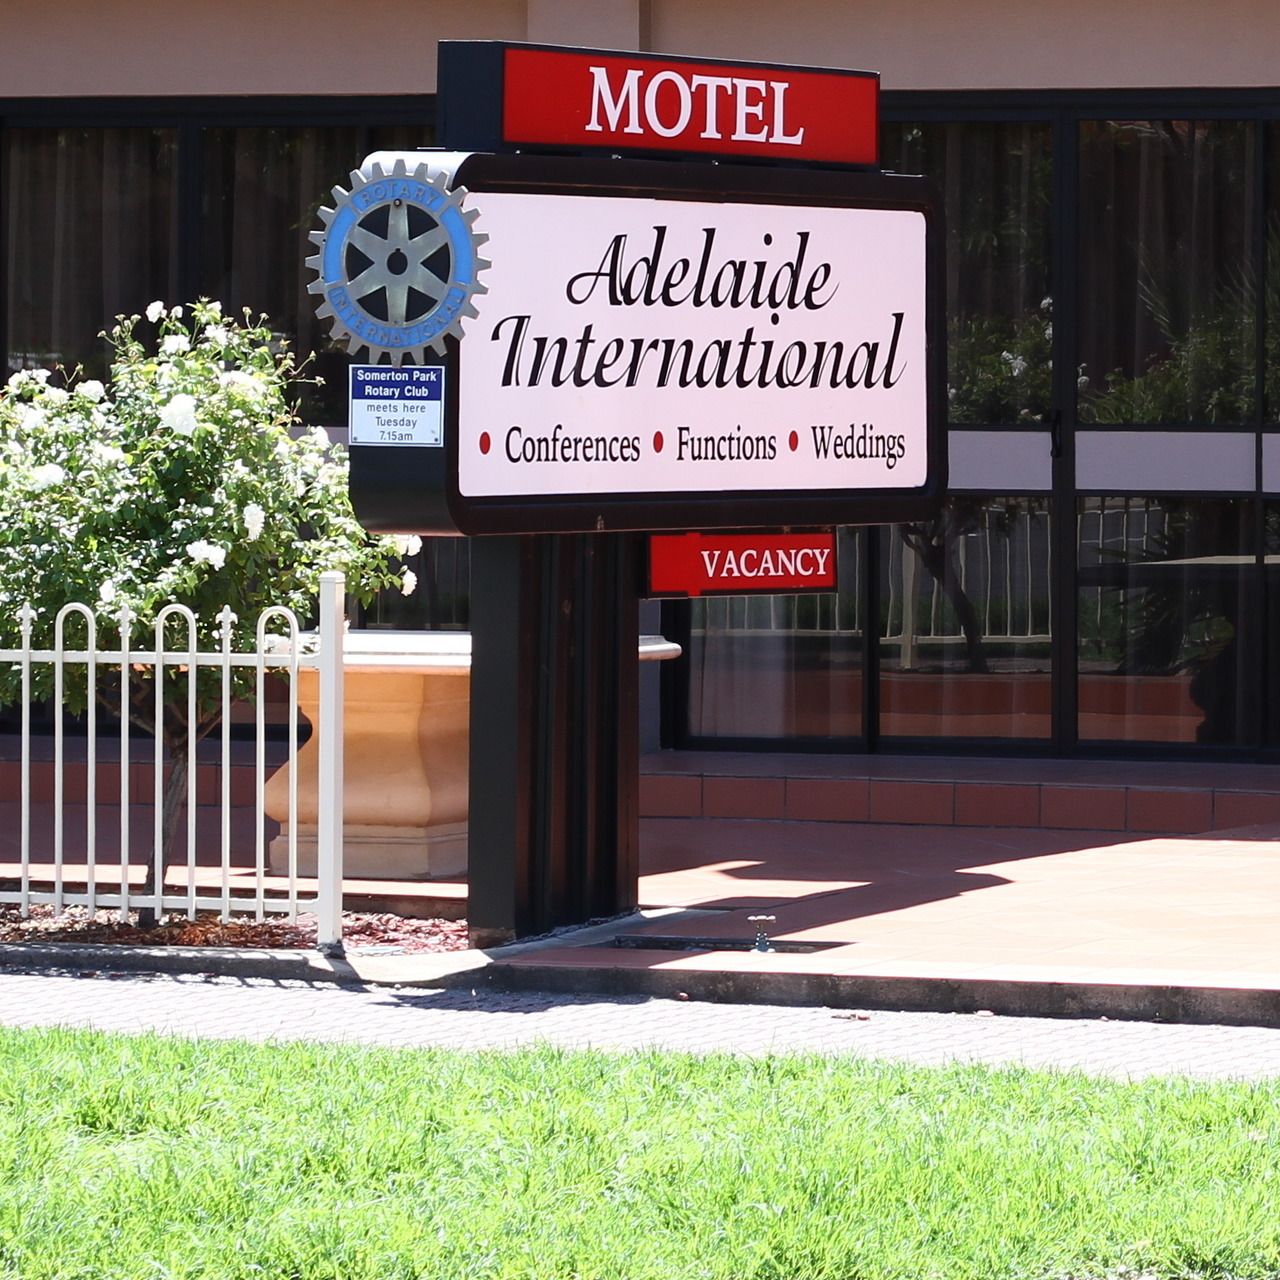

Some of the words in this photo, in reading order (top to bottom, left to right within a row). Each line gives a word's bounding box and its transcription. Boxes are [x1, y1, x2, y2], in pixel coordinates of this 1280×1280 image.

[584, 66, 806, 146] MOTEL
[360, 179, 440, 207] ROTARY
[566, 225, 838, 310] Adelaide
[329, 287, 467, 346] INTERNATIONAL
[490, 312, 907, 389] International
[357, 369, 409, 381] Somerton
[413, 371, 437, 382] Park
[364, 385, 400, 399] Rotary
[404, 385, 429, 397] Club
[366, 403, 398, 413] meets
[402, 403, 426, 413] here
[376, 416, 418, 429] Tuesday
[380, 430, 413, 441] 7.15am
[505, 423, 641, 464] Conferences
[676, 424, 777, 462] Functions
[810, 423, 906, 470] Weddings
[700, 548, 831, 578] VACANCY
